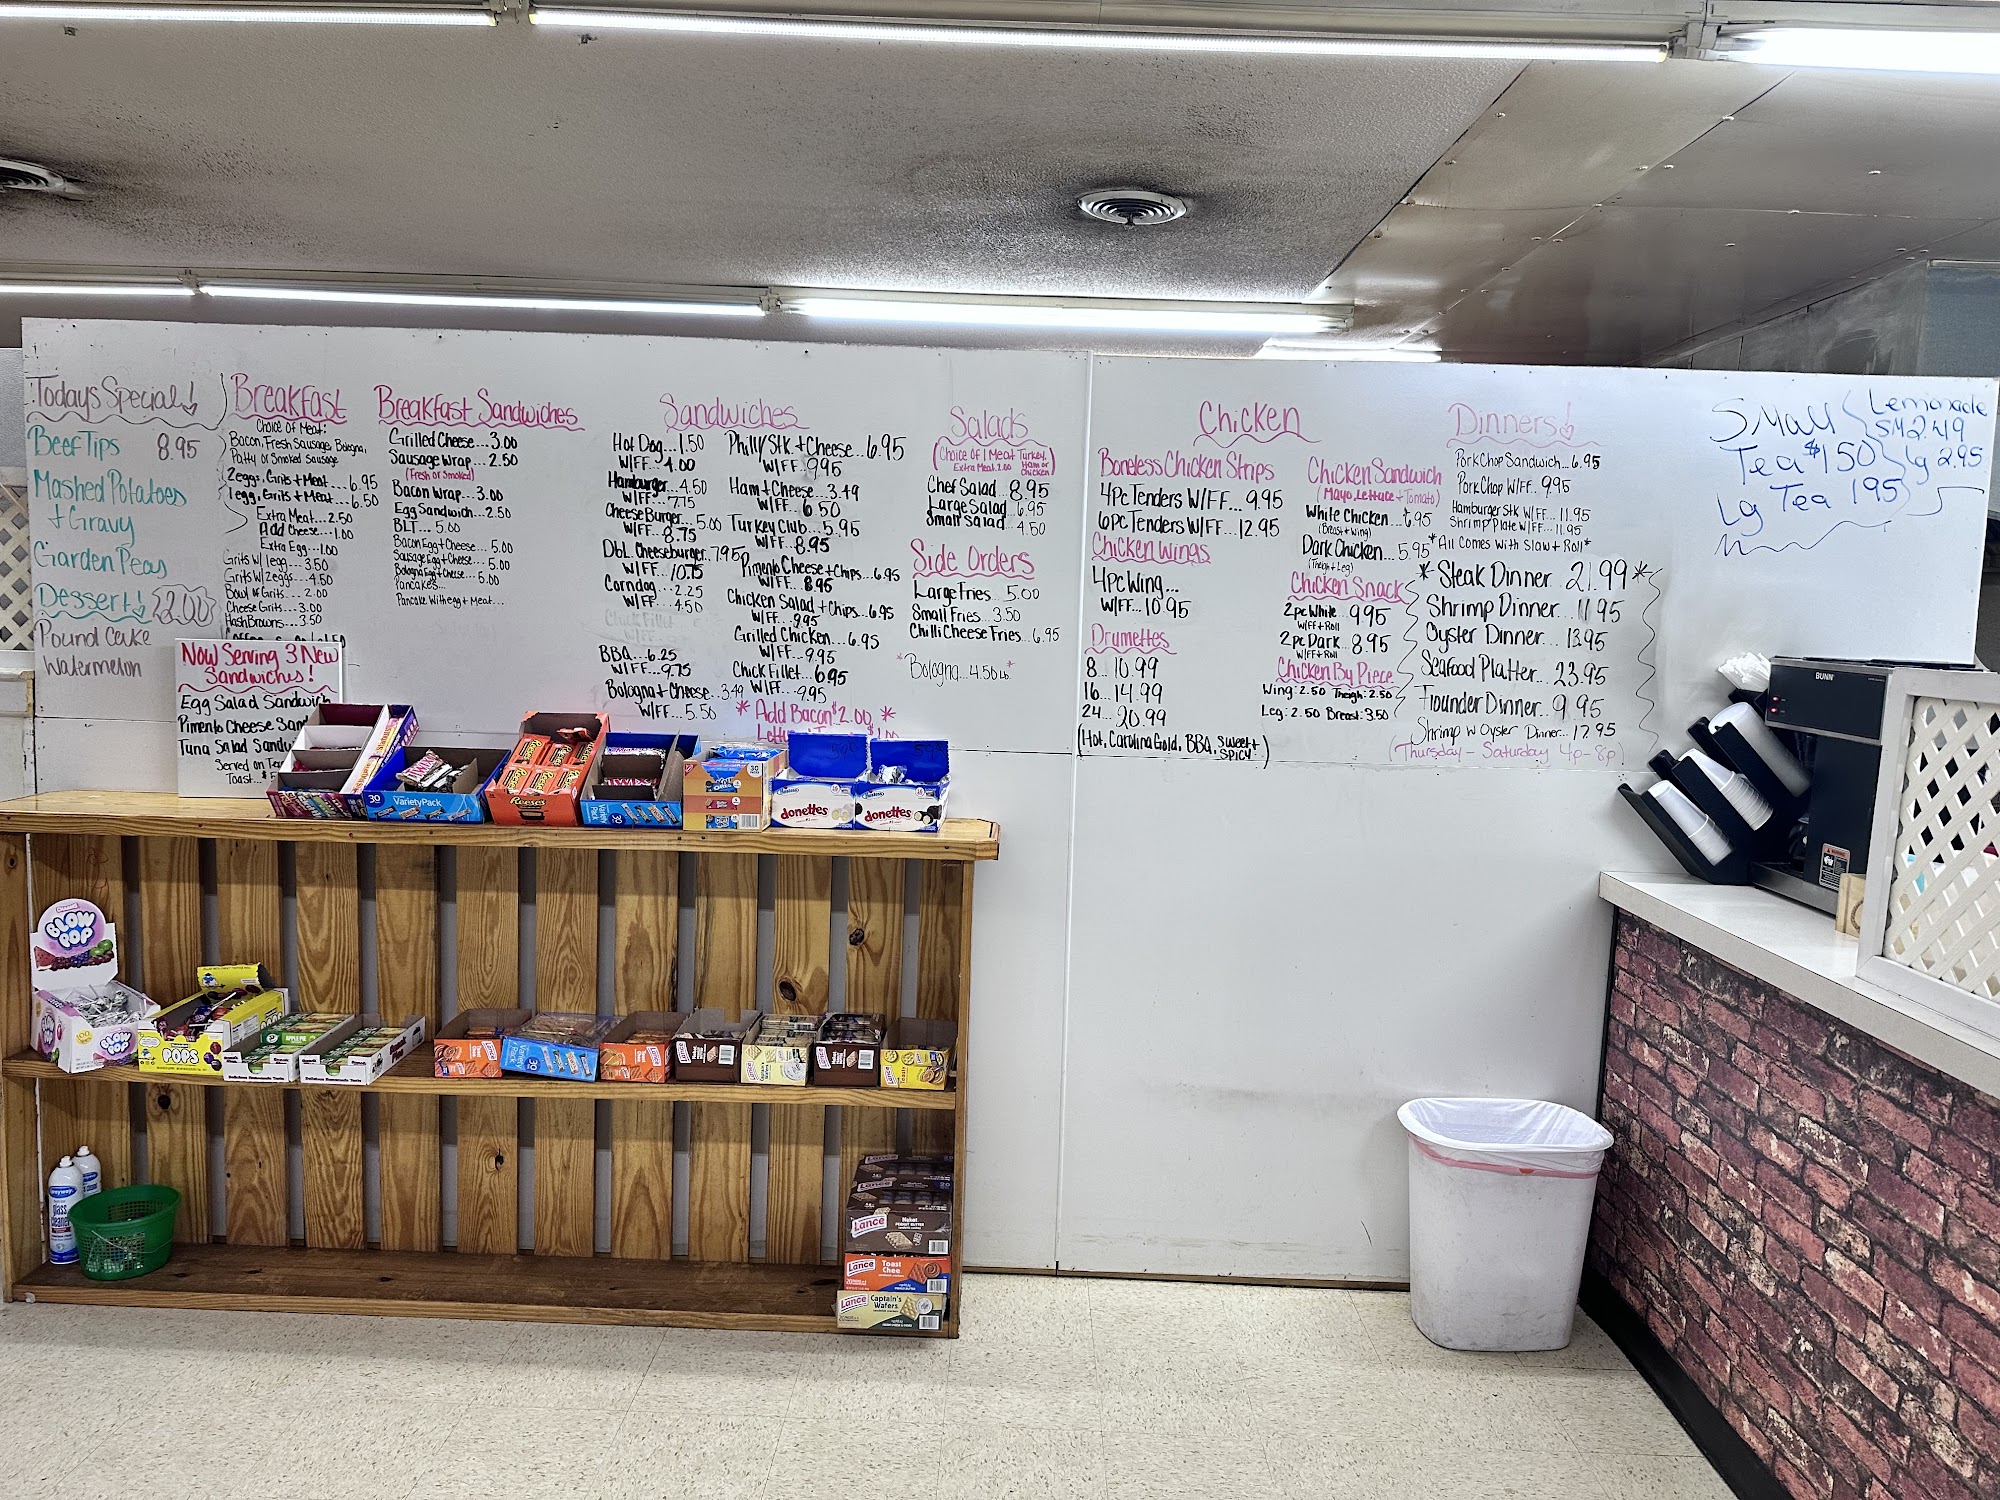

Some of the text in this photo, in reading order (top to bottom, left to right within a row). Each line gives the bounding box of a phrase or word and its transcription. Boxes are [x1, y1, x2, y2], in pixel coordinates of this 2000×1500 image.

[477, 388, 578, 425] Sandwiches
[659, 393, 799, 429] Sandwiches
[1869, 388, 1987, 416] Lemonade
[257, 419, 282, 433] Choice
[950, 406, 1028, 439] Salads
[1199, 400, 1300, 437] Chicken
[77, 429, 120, 461] Tips
[264, 436, 291, 449] Fresh
[389, 427, 435, 447] Grilled
[614, 432, 634, 451] Hot
[157, 433, 201, 461] 8.95
[989, 449, 1015, 460] Meat
[229, 448, 301, 466] Patty Smoked
[389, 450, 440, 469] Sausage
[1098, 447, 1275, 483] Boneless Chicken Strips
[1720, 445, 1804, 485] Tea
[1937, 447, 1983, 469] 2.95
[266, 469, 292, 485] Grits
[954, 464, 975, 472] Extra
[1308, 456, 1442, 485] Chicken Sandwich
[33, 469, 187, 507] Mashed Potatoes
[263, 489, 291, 501] Grits
[393, 477, 429, 498] Bacon
[729, 477, 760, 496] Ham
[1129, 483, 1182, 509] Tenders
[1770, 484, 1831, 512] Tea
[257, 506, 286, 521] Extra
[395, 502, 417, 519] Egg
[1306, 505, 1340, 522] White
[1453, 500, 1501, 519] Hamburger
[68, 506, 135, 547] Gravy
[260, 522, 284, 536] Add
[728, 513, 775, 535] Turkey
[1128, 510, 1184, 534] Tenders
[1092, 532, 1154, 559] Chicken
[1302, 534, 1332, 557] Dark
[1459, 539, 1490, 549] Comes
[1524, 539, 1550, 551] Slaw
[33, 541, 167, 578] Garden Peas
[910, 538, 1034, 574] Side Orders
[1437, 560, 1485, 589] Steak
[914, 580, 957, 607] Large
[1291, 571, 1404, 598] Chicken Snack
[227, 602, 256, 613] Cheese
[728, 589, 815, 613] Chicken Salad
[1426, 594, 1494, 622] Shrimp
[912, 603, 947, 621] Small
[36, 619, 99, 649] Pound
[734, 626, 776, 642] Grilled
[910, 623, 941, 639] Chilli
[943, 624, 988, 639] Cheese
[1091, 623, 1170, 648] Drumettes
[1426, 622, 1477, 653] Oyster
[182, 642, 339, 671] Now Serving 3 New
[1422, 649, 1475, 679] Seafood
[44, 655, 142, 678] Watermelon
[733, 661, 766, 678] Chick
[1278, 656, 1394, 685] Chicken By Piece
[1816, 672, 1834, 680] BUNN
[181, 694, 259, 716] Egg Salad
[1414, 685, 1482, 715] Flounder
[756, 698, 832, 725] Add Bacon
[226, 719, 274, 734] Cheese
[1480, 723, 1518, 740] Oyster
[178, 738, 247, 755] Tuna Salad
[1110, 730, 1150, 748] Carolina
[1482, 742, 1548, 764] Saturday
[215, 759, 249, 771] Served
[368, 795, 380, 803] 30
[781, 804, 828, 820] donettes
[864, 805, 912, 822] donettes
[46, 911, 97, 938] BLOW
[58, 926, 95, 950] POP
[100, 1030, 132, 1049] BLOW
[109, 1041, 131, 1055] POP
[163, 1048, 199, 1064] POPS
[483, 1041, 497, 1060] Lance
[648, 1047, 661, 1065] Lance
[678, 1043, 689, 1062] Lance
[817, 1048, 829, 1068] Lance
[746, 1062, 758, 1081] Lance
[885, 1066, 896, 1085] Lance
[53, 1204, 67, 1216] glass
[853, 1217, 885, 1232] Lance
[849, 1261, 874, 1272] Lance
[841, 1296, 867, 1309] Lance
